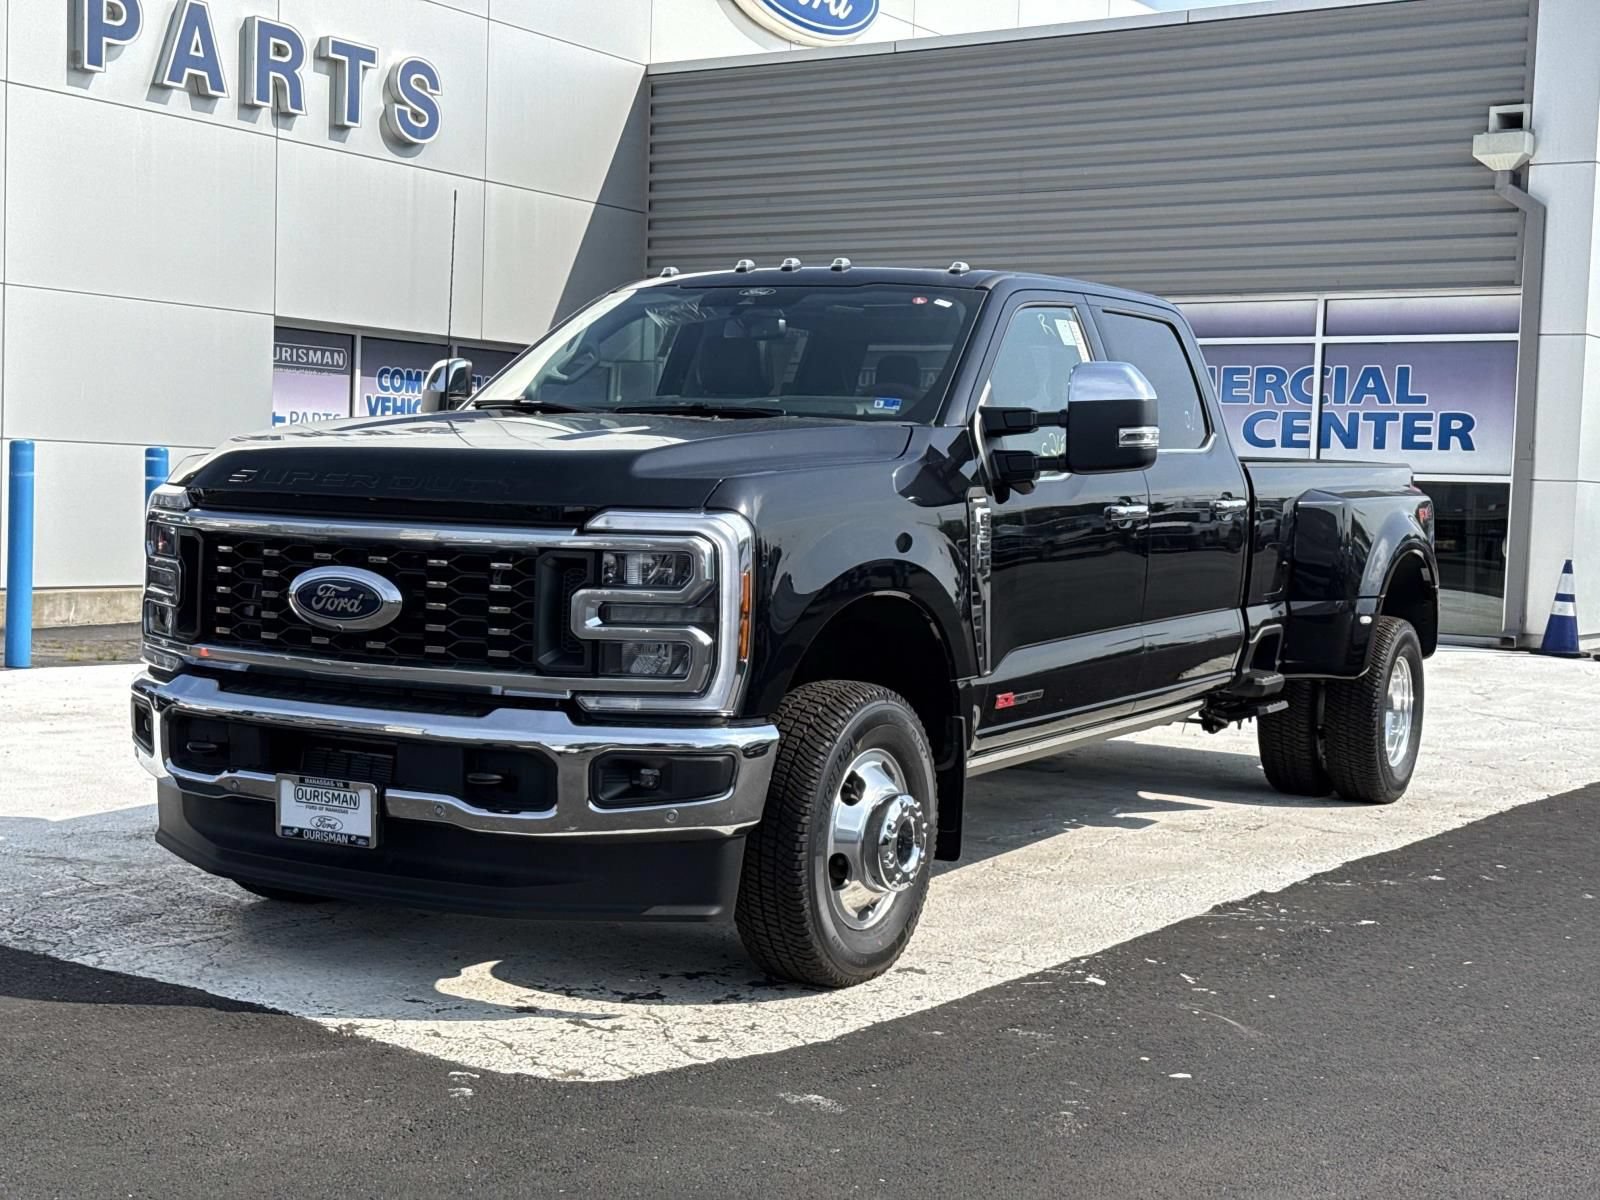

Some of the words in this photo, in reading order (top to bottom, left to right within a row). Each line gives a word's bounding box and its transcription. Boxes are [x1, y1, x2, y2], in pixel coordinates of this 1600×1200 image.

[80, 0, 443, 144] PARTS
[1241, 409, 1477, 452] CENTER
[227, 468, 379, 489] SUPER
[311, 583, 363, 613] Ford
[296, 787, 357, 807] OURISMAN
[315, 816, 338, 830] Ford
[303, 830, 348, 843] OURISMAN
